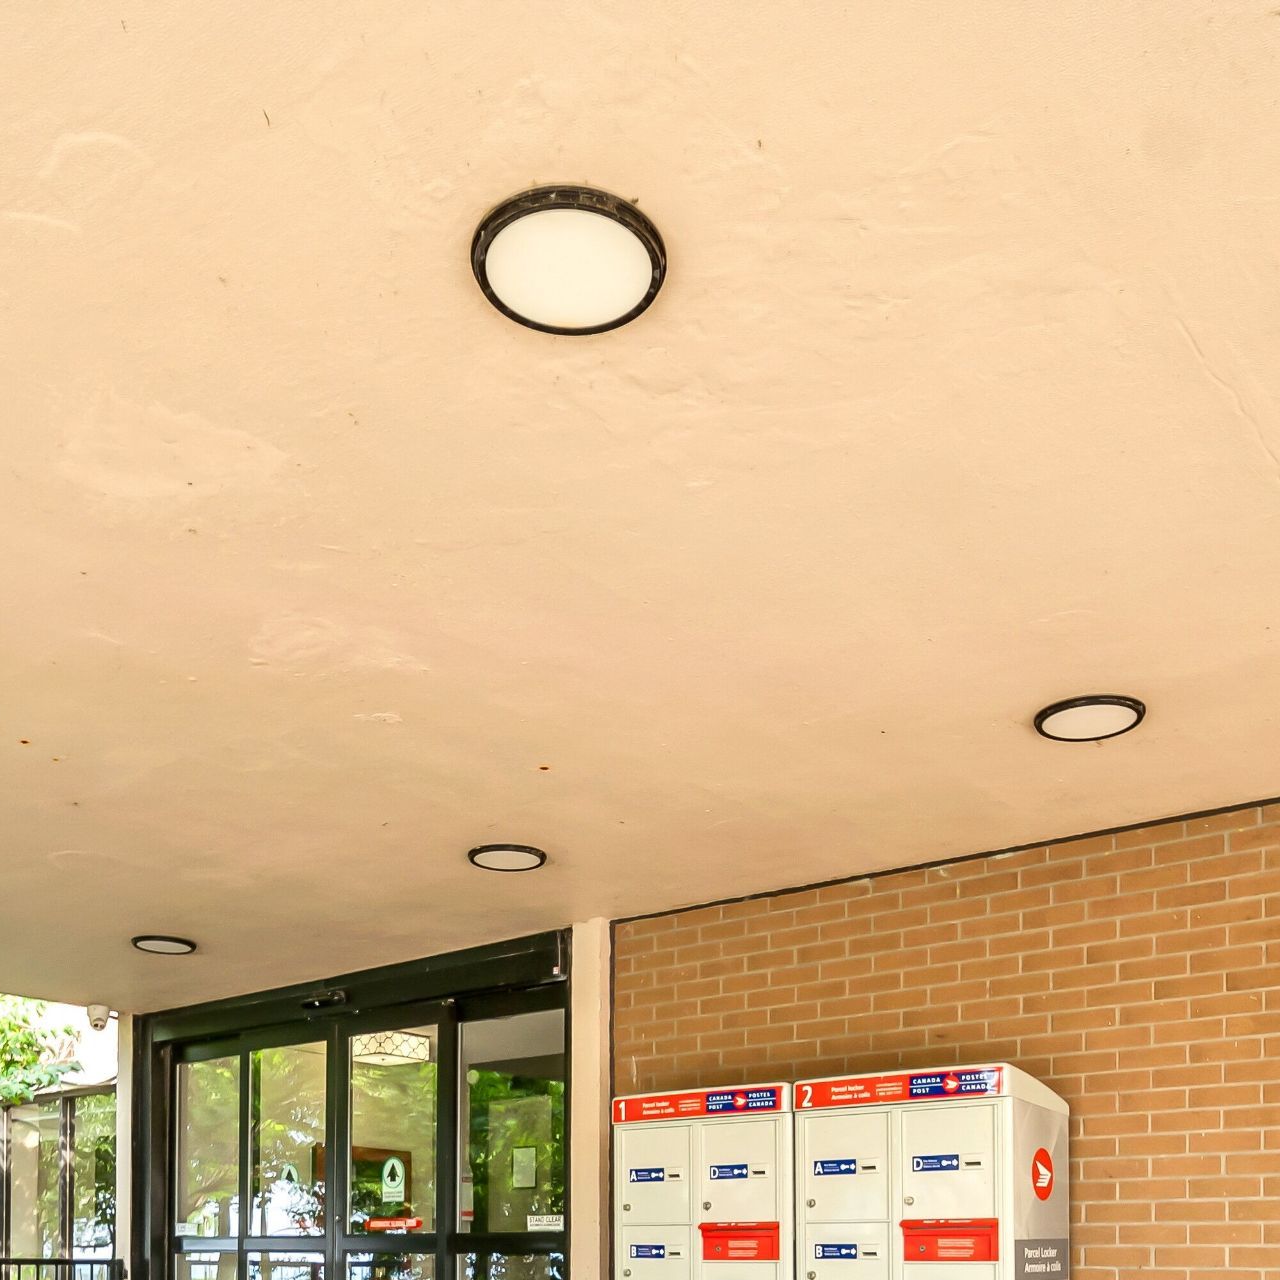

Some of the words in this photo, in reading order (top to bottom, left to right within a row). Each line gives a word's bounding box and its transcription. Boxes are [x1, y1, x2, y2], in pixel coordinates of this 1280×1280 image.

[801, 1086, 813, 1108] 2
[619, 1101, 626, 1121] 1
[815, 1162, 824, 1174] A
[913, 1158, 923, 1170] D
[630, 1171, 637, 1181] A
[710, 1167, 719, 1179] D
[631, 1246, 637, 1257] B
[815, 1246, 823, 1257] B
[1024, 1247, 1040, 1258] Parcel
[1041, 1246, 1057, 1258] Locker
